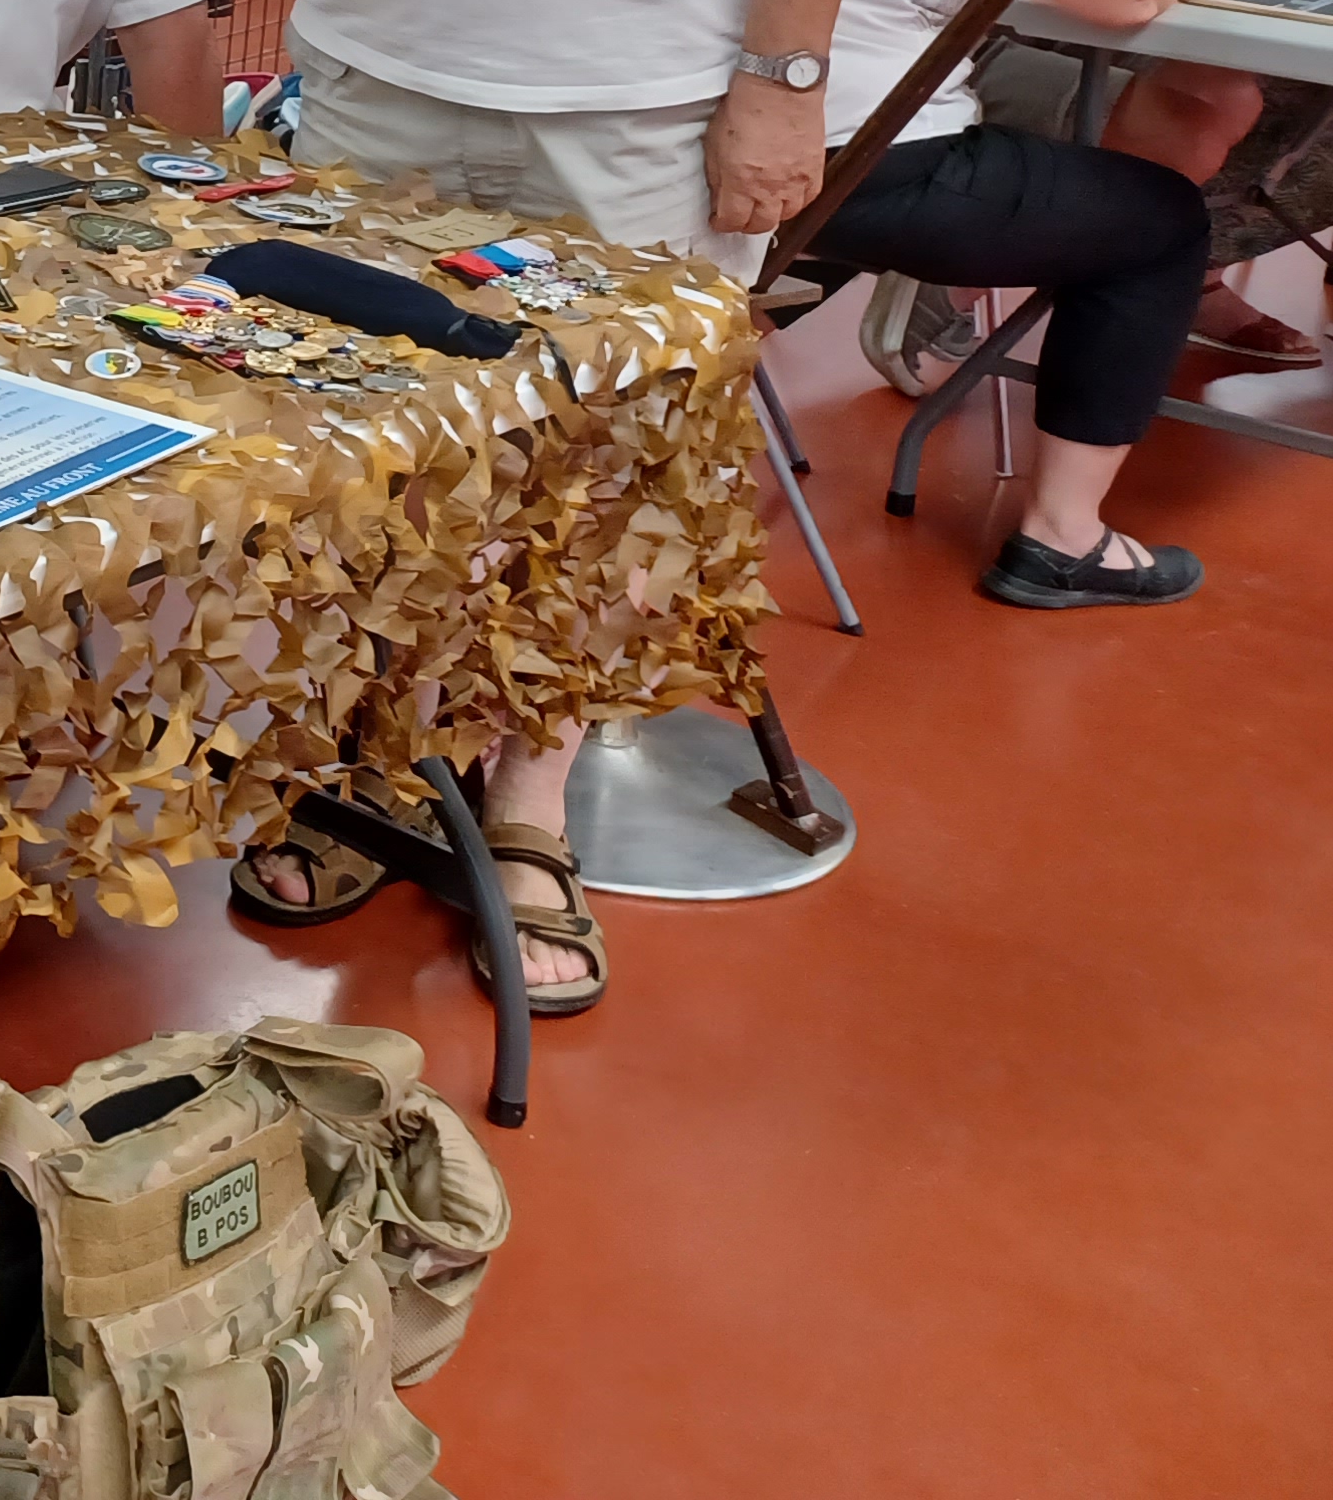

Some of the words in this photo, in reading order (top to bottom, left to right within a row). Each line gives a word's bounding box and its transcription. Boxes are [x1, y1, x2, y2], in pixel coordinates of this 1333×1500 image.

[21, 485, 46, 501] AU
[47, 461, 101, 490] FRONT
[189, 1170, 255, 1222] BOUBOU
[196, 1229, 210, 1248] B
[214, 1208, 252, 1239] POS
